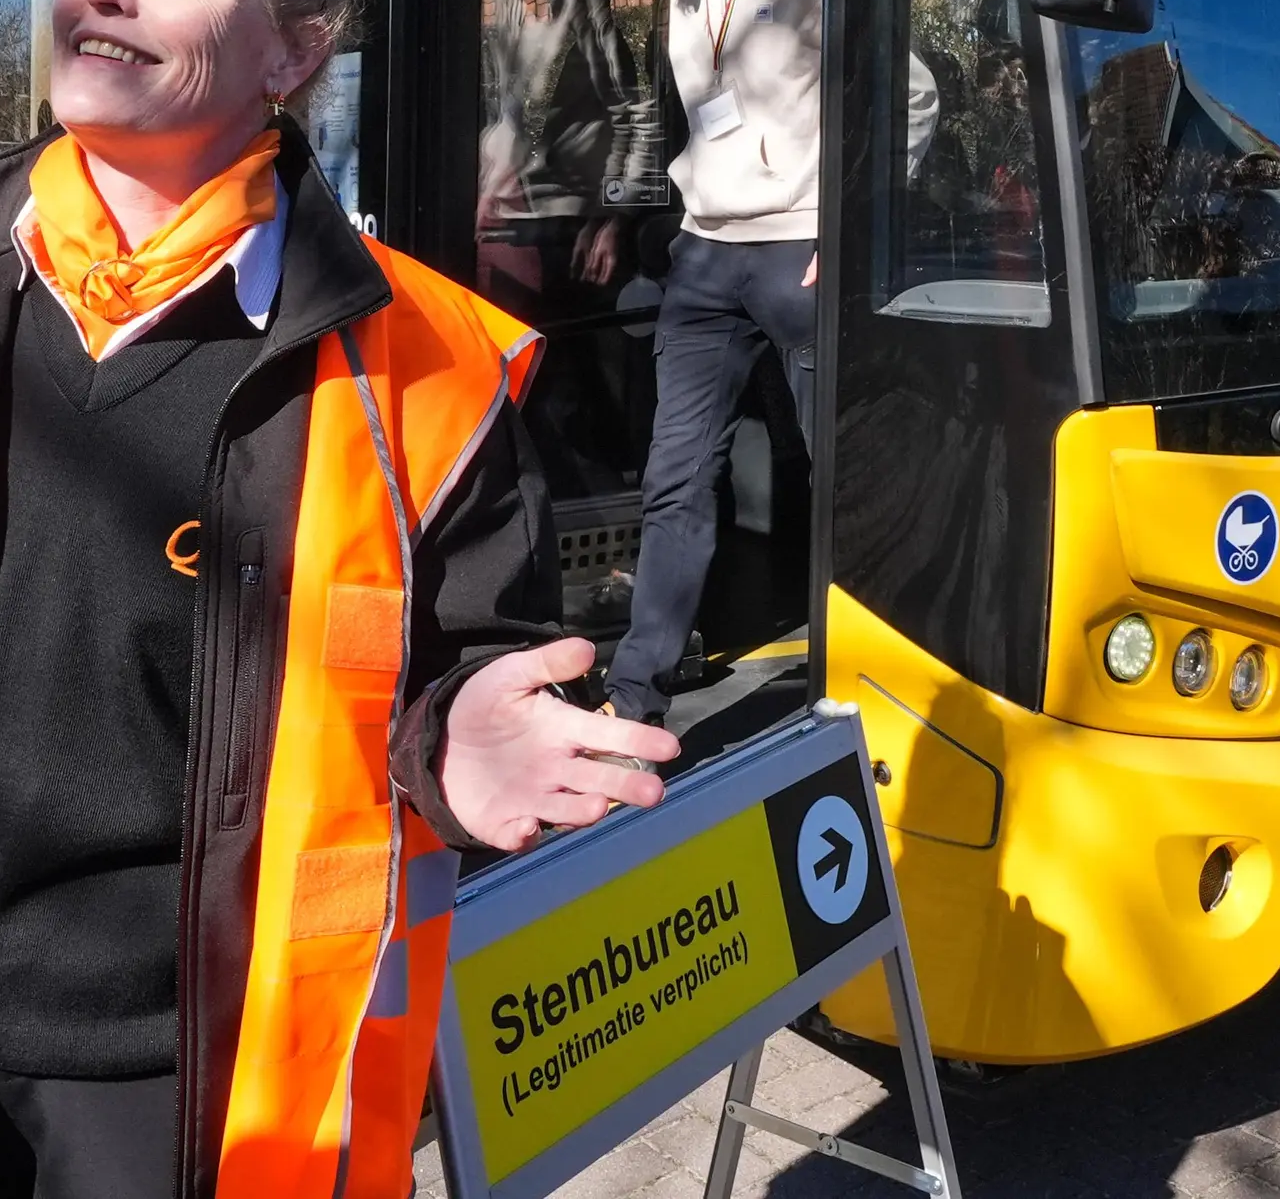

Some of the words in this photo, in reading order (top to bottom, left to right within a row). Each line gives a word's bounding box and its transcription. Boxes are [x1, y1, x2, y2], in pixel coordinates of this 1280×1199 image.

[491, 880, 740, 1055] Stembureau
[502, 1002, 645, 1117] (Legitimatie
[650, 931, 748, 1013] verplicht)
